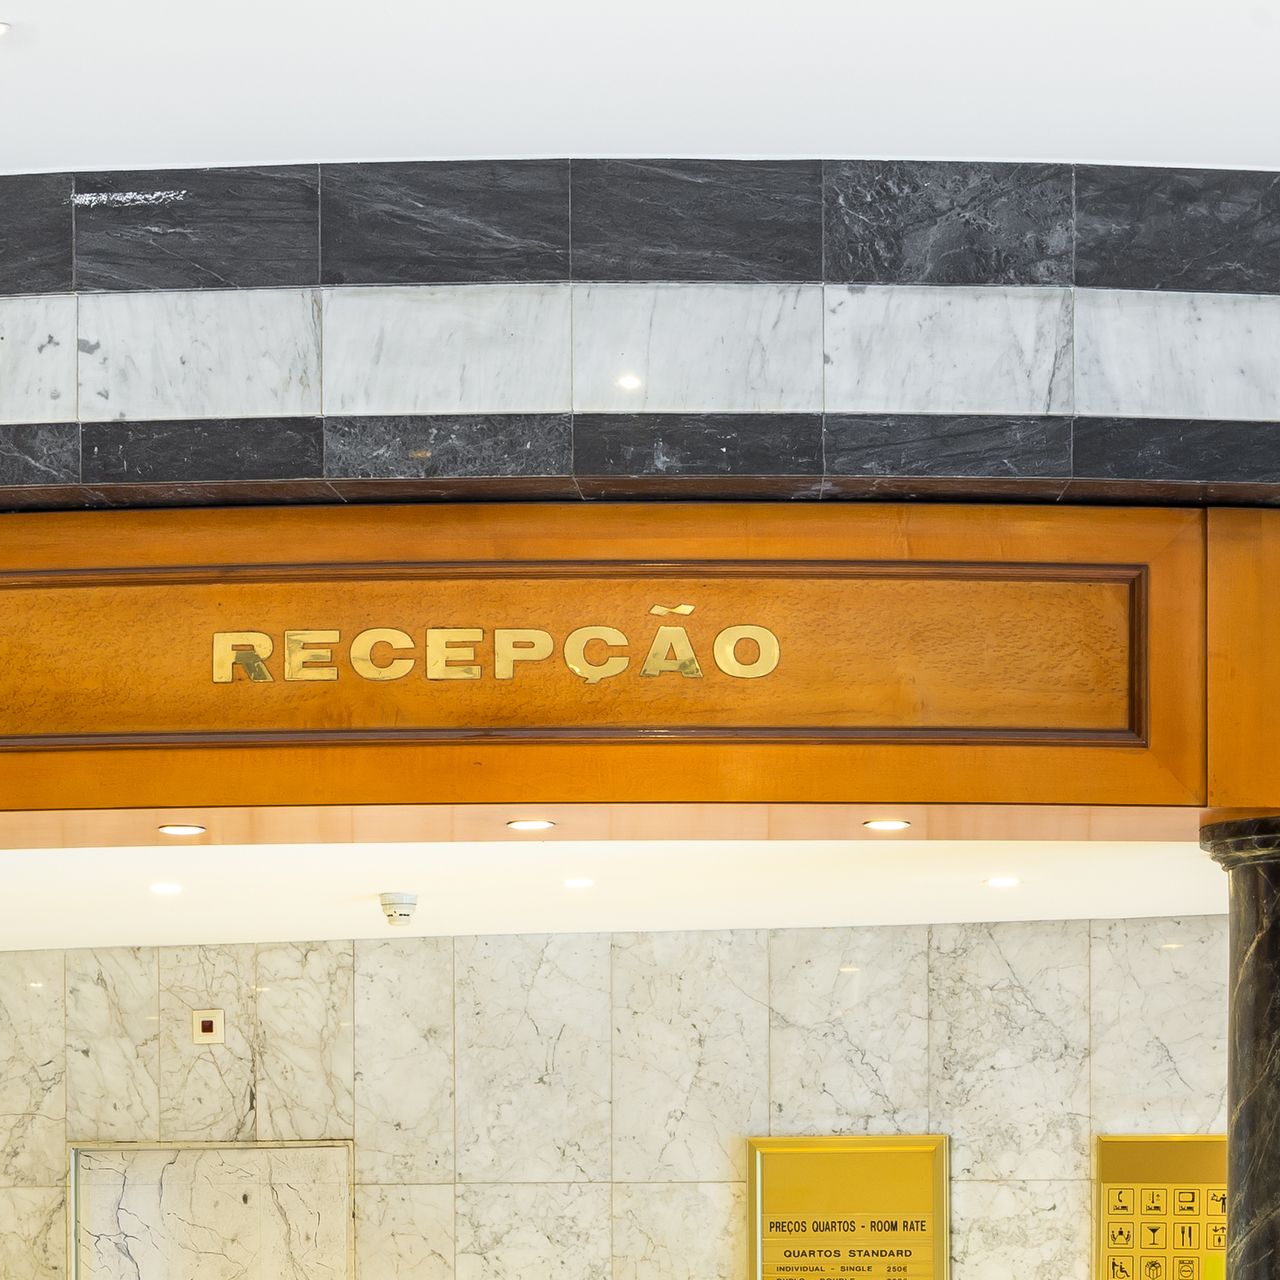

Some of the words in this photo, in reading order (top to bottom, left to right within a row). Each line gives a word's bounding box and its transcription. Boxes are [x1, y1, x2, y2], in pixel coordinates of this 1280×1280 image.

[212, 603, 781, 684] RECEPÇÃO
[769, 1220, 807, 1235] PREÇOS
[812, 1220, 856, 1233] QUARTOS
[870, 1220, 898, 1232] ROOM
[903, 1220, 927, 1232] RATE
[783, 1249, 841, 1258] QUARTOS
[848, 1249, 912, 1258] STANDARD
